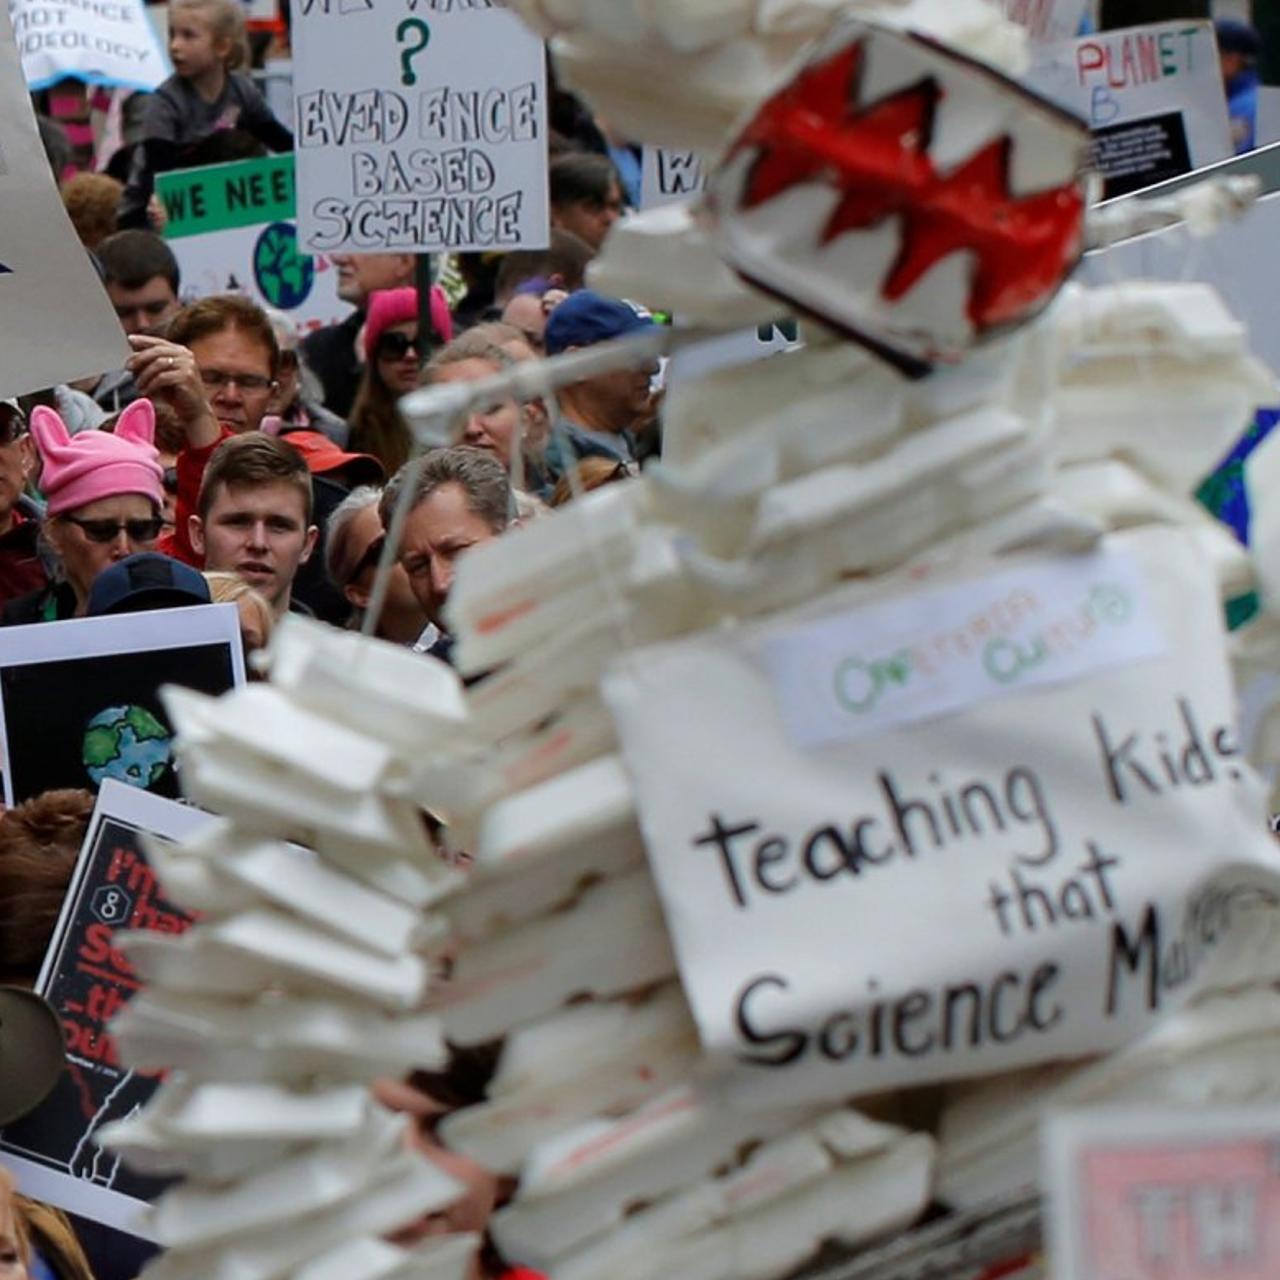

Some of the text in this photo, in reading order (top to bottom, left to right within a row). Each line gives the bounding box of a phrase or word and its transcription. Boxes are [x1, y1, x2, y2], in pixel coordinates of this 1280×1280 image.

[1077, 27, 1199, 89] PLANET
[296, 81, 539, 148] EVIDENCE
[1092, 85, 1120, 124] B
[163, 169, 294, 223] WE NEE
[351, 147, 496, 198] BASED
[307, 190, 524, 251] SCIENCE
[987, 842, 1122, 937] that
[735, 962, 1065, 1067] Science
